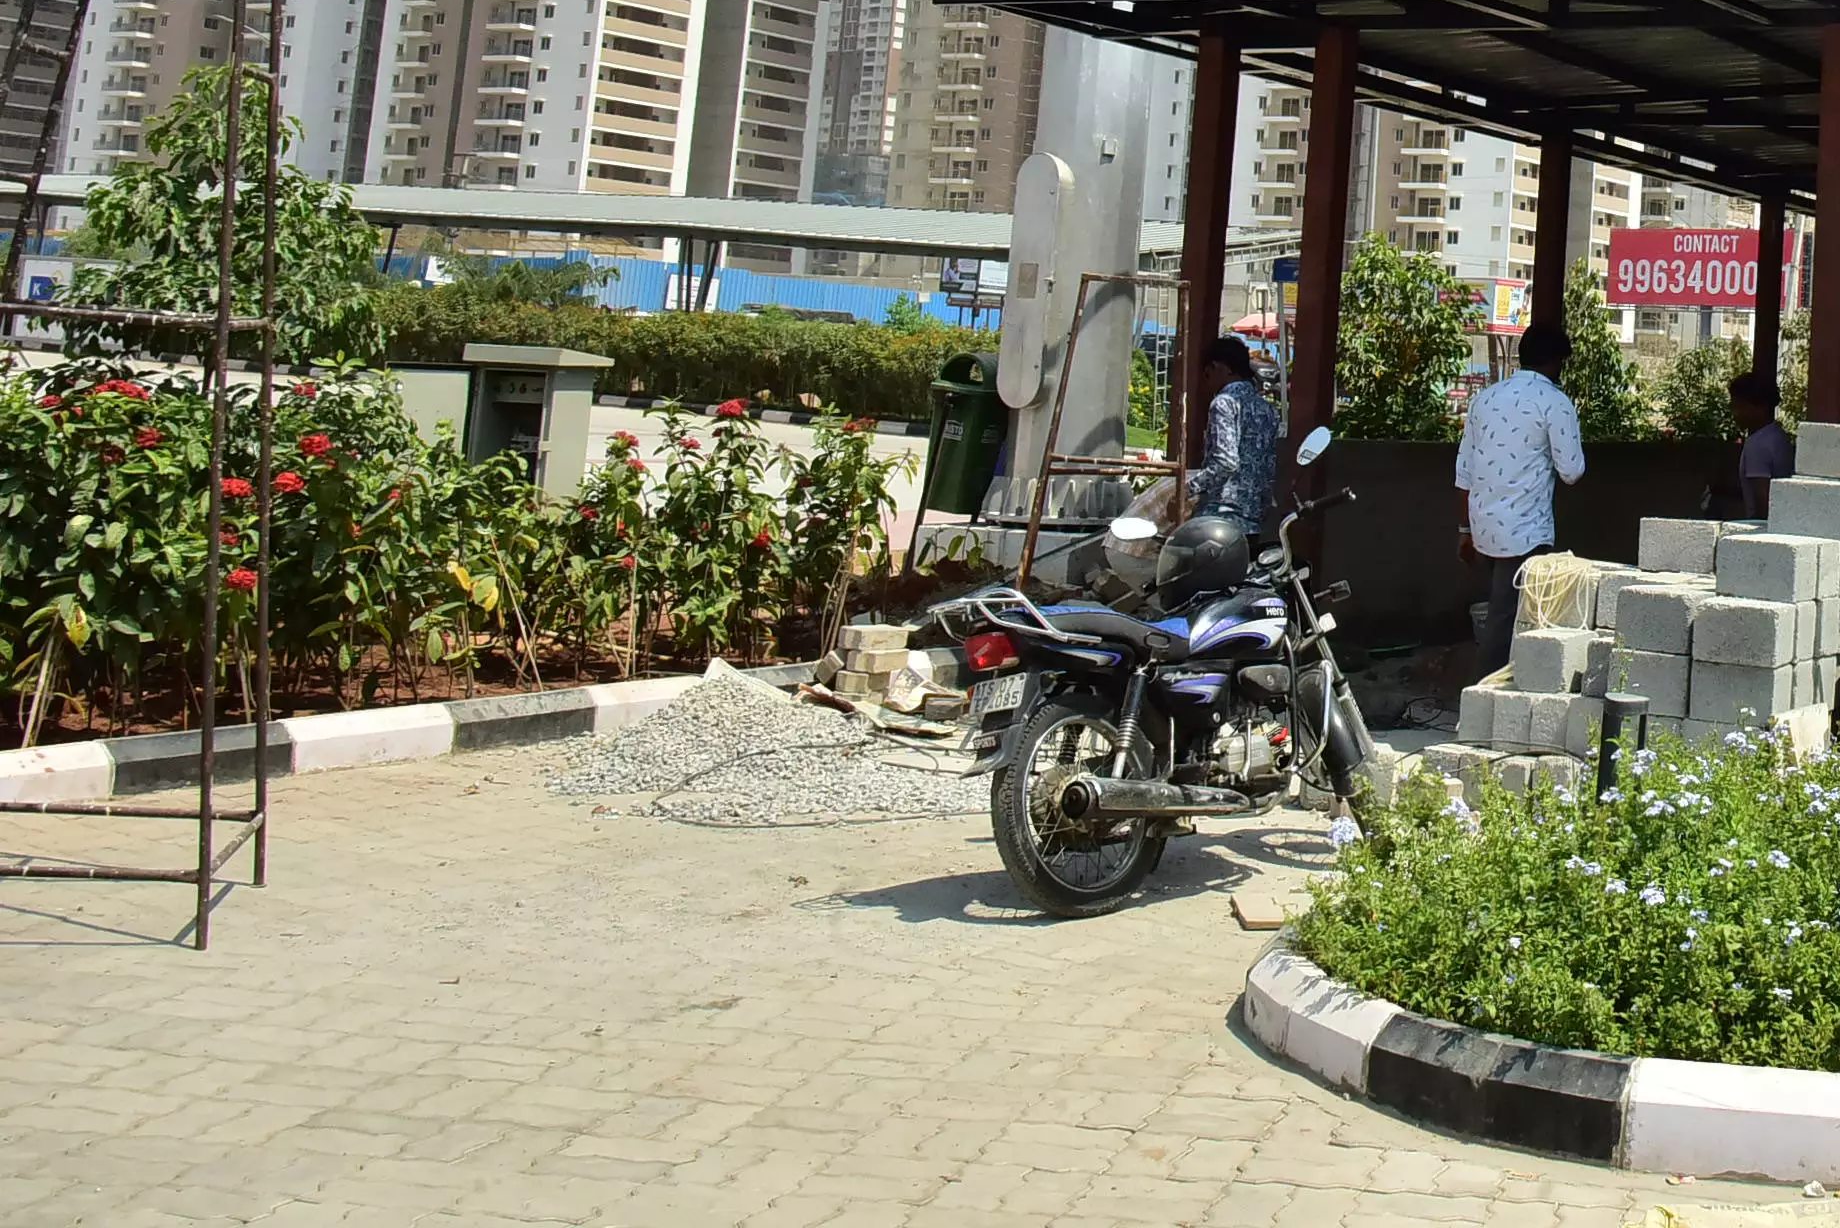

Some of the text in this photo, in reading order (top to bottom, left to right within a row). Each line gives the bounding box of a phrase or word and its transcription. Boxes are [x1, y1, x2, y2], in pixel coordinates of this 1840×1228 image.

[1673, 234, 1740, 254] CONTACT
[1618, 259, 1791, 296] 996340001
[1000, 677, 1015, 693] 07
